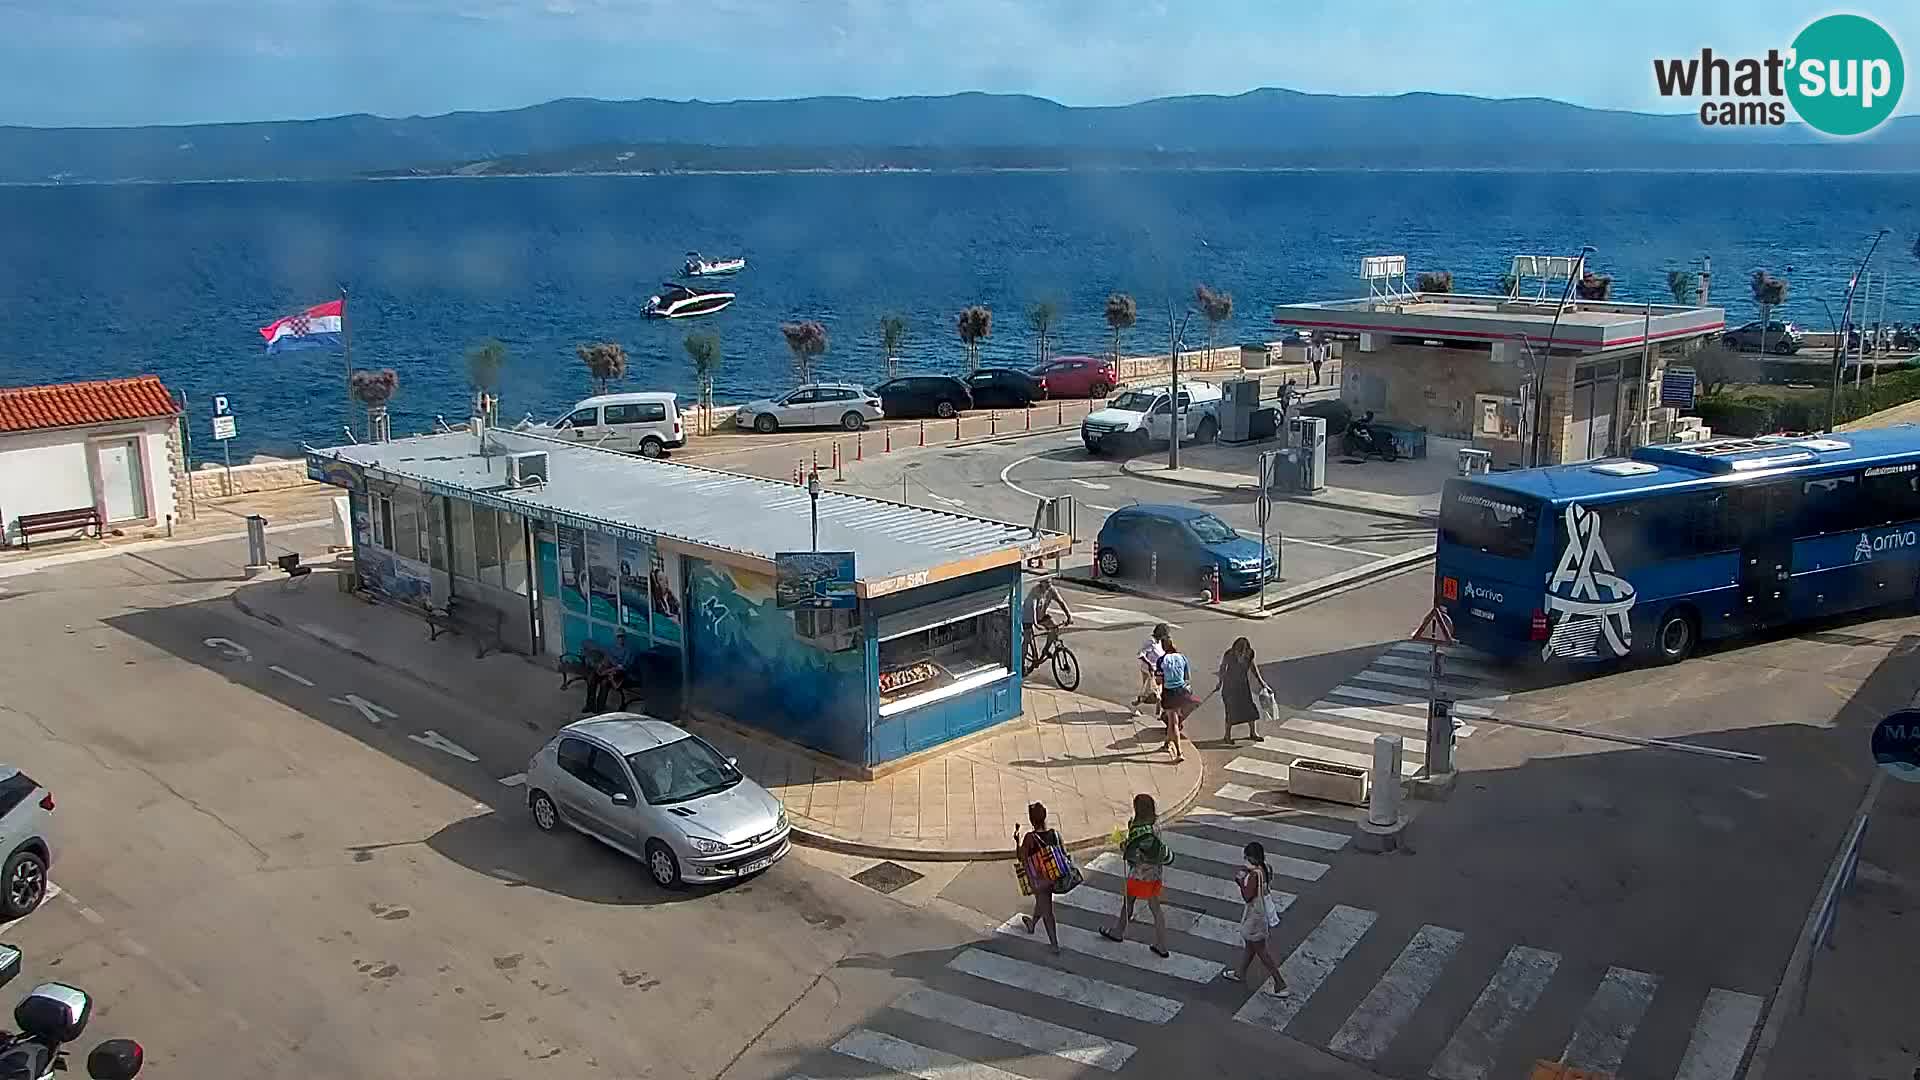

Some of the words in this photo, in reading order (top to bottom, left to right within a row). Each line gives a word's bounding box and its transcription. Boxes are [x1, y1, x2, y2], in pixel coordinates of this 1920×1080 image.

[216, 396, 229, 415] P
[568, 516, 598, 532] STATION
[601, 525, 625, 538] TICKET
[627, 531, 653, 544] OFFICE
[1873, 529, 1916, 551] arriva
[1476, 587, 1504, 603] arriva
